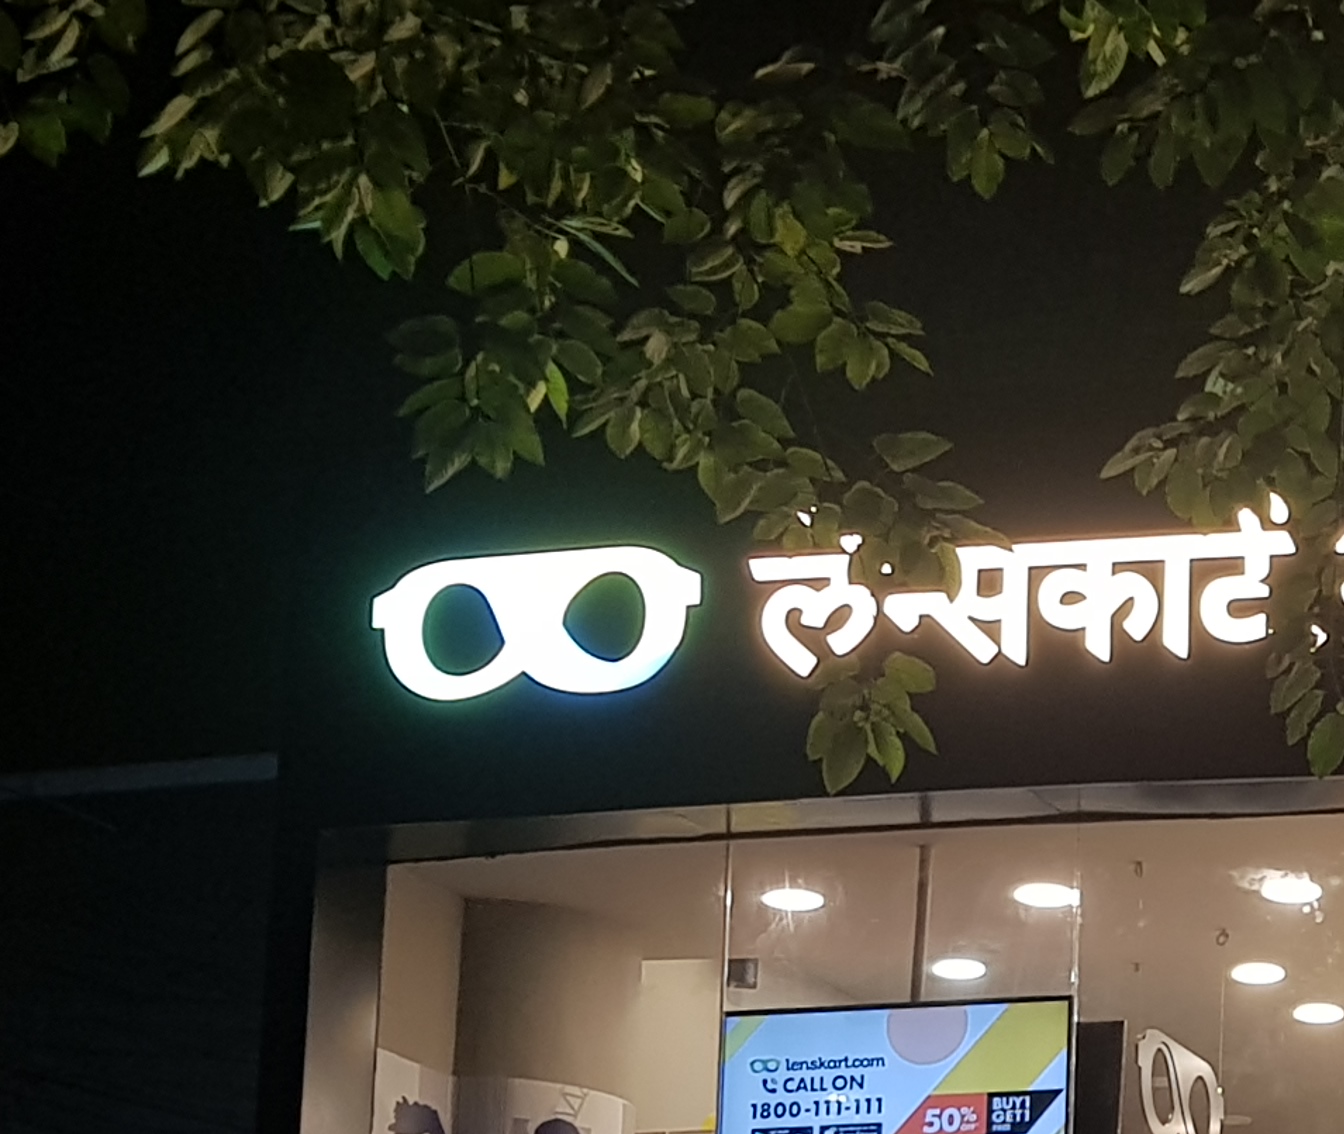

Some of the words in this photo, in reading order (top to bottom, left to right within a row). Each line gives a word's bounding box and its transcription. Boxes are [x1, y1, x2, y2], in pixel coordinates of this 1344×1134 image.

[785, 1056, 886, 1071] lenskart.com
[783, 1076, 827, 1093] CALL
[832, 1074, 865, 1091] ON
[750, 1097, 883, 1120] 1800-111-111
